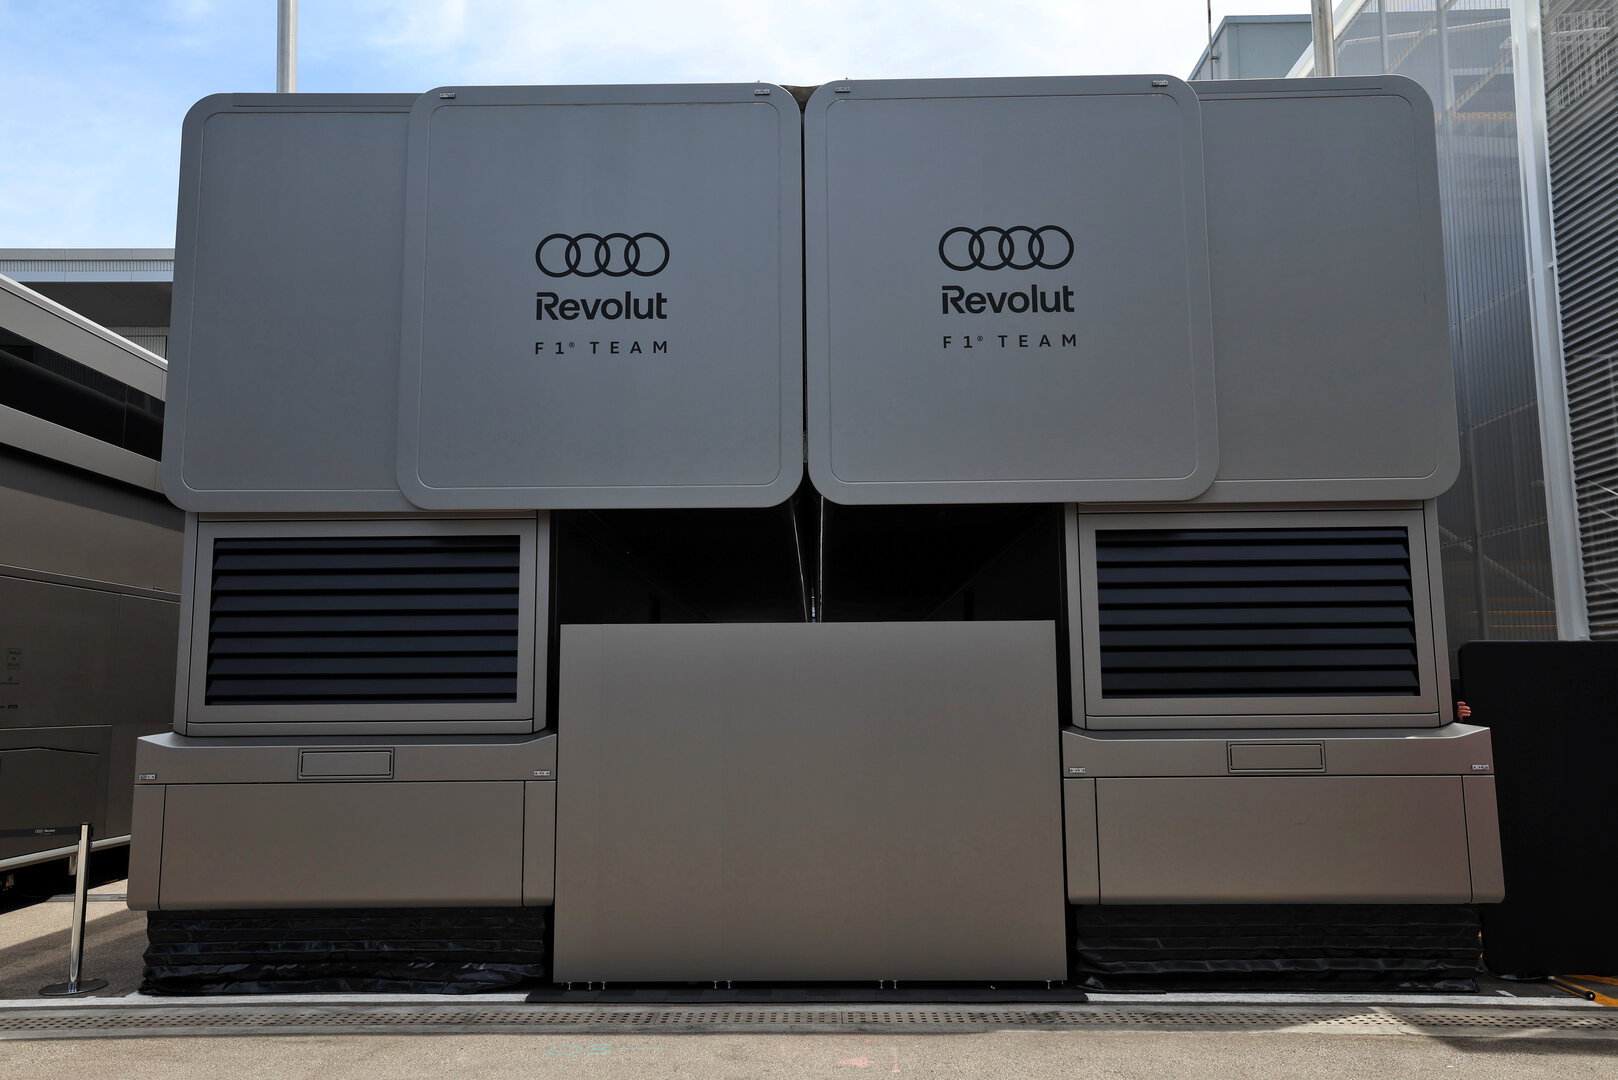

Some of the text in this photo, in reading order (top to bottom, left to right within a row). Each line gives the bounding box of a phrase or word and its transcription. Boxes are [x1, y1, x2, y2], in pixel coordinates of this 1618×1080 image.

[536, 291, 668, 321] Revolut
[941, 284, 1075, 315] Revolut
[590, 340, 668, 355] TEAM
[997, 333, 1077, 348] TEAM
